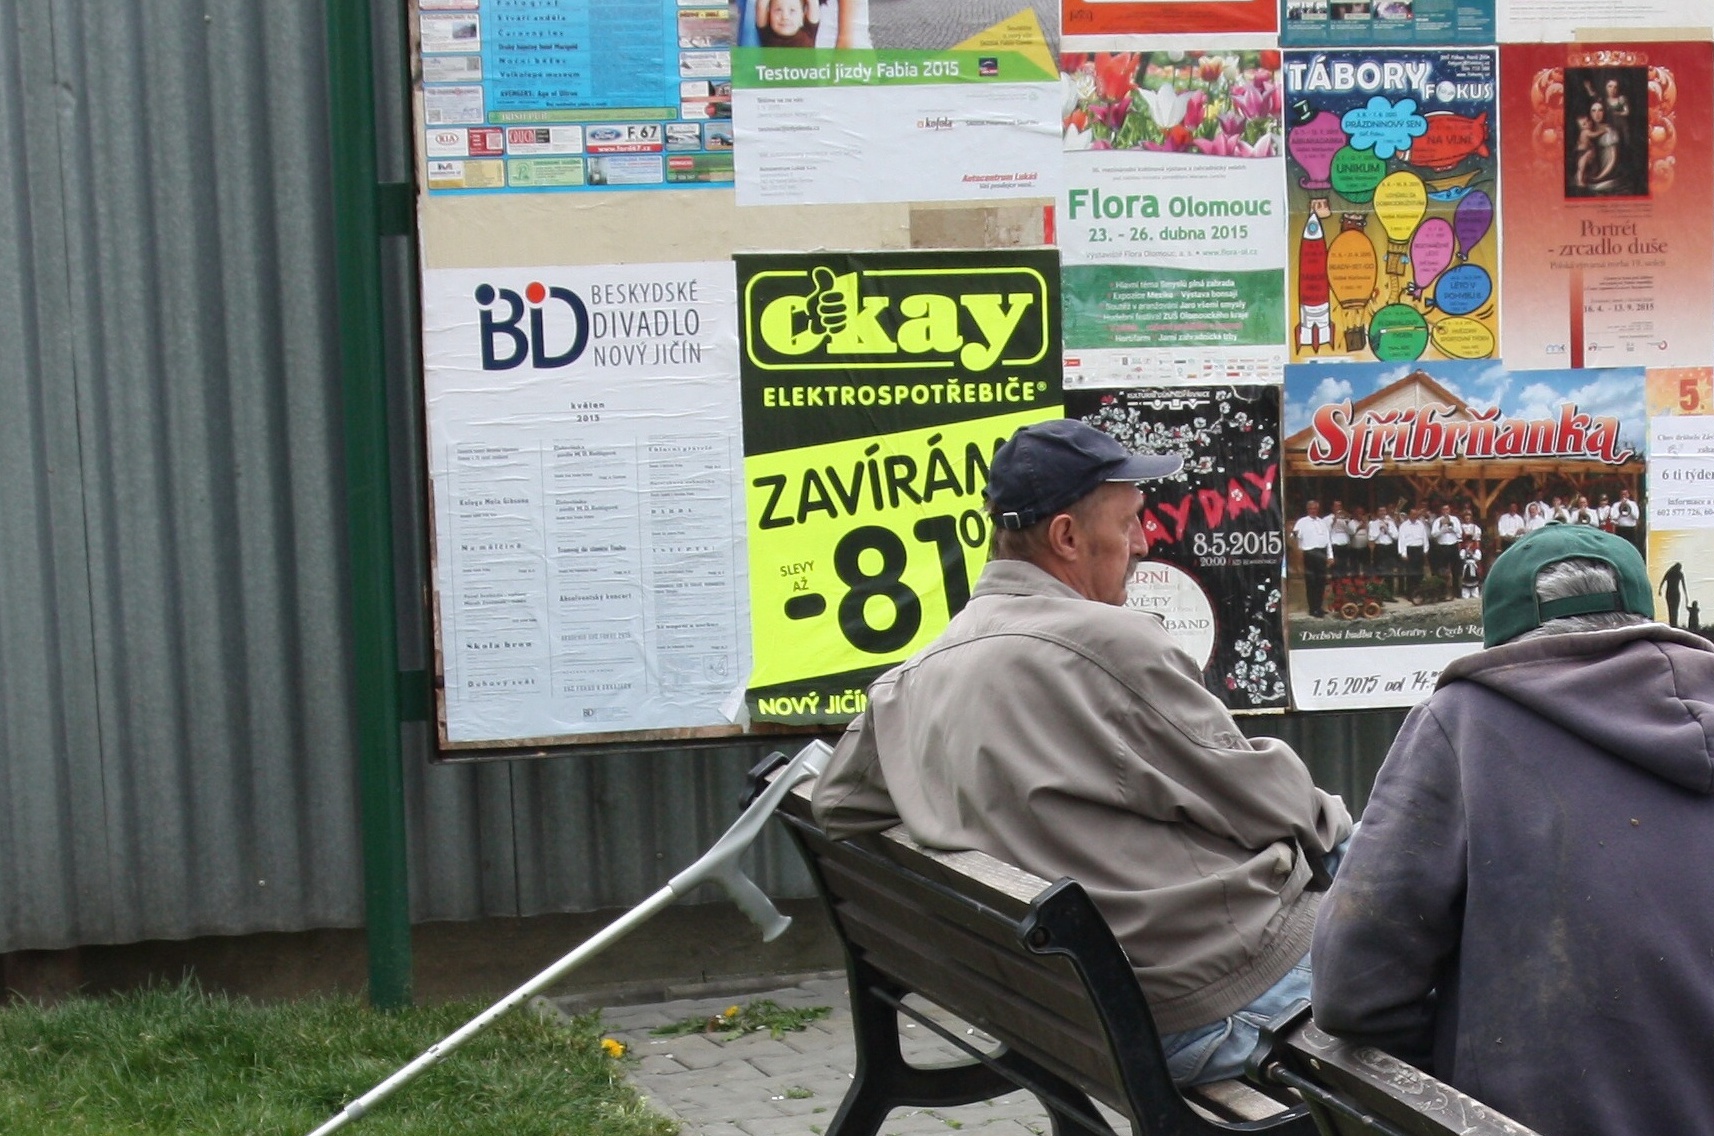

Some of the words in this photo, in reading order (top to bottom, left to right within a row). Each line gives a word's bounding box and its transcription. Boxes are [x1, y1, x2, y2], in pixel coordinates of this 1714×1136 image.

[833, 64, 871, 83] jízdy
[877, 63, 918, 78] Fabia
[922, 61, 959, 77] 2015
[1289, 55, 1429, 92] TÁBORY
[1425, 81, 1493, 102] FOKUS
[925, 117, 953, 131] kofola
[1406, 119, 1422, 128] SEN
[1427, 135, 1443, 145] NA
[1336, 163, 1380, 174] UNIKUM
[1068, 187, 1160, 220] Flora
[1168, 196, 1273, 218] Olomouc
[1089, 228, 1113, 242] 23.
[1130, 227, 1154, 241] 26.
[1159, 226, 1206, 241] dubna
[1211, 225, 1248, 239] 2015
[1580, 219, 1637, 237] Portrét
[1124, 250, 1142, 258] Flora
[1559, 238, 1623, 256] zrcadlo
[1628, 237, 1669, 254] duše
[591, 280, 699, 306] BESKYDSKÉ
[592, 308, 701, 339] DIVADLO
[594, 337, 649, 368] NOVÝ
[652, 335, 702, 366] JIČÍN
[1309, 398, 1637, 480] Stříbrňanka
[1662, 470, 1669, 480] 6
[1673, 469, 1681, 480] ti
[1141, 463, 1278, 548] AYDAY
[1193, 531, 1282, 556] 8.5.2015
[780, 561, 815, 578] SLEVY
[1127, 567, 1170, 584] RNÍ
[792, 576, 810, 592] AŽ
[1165, 619, 1210, 630] BAND
[1345, 629, 1372, 640] hudba
[1436, 625, 1463, 638] Czech
[758, 691, 820, 716] NOVÝ
